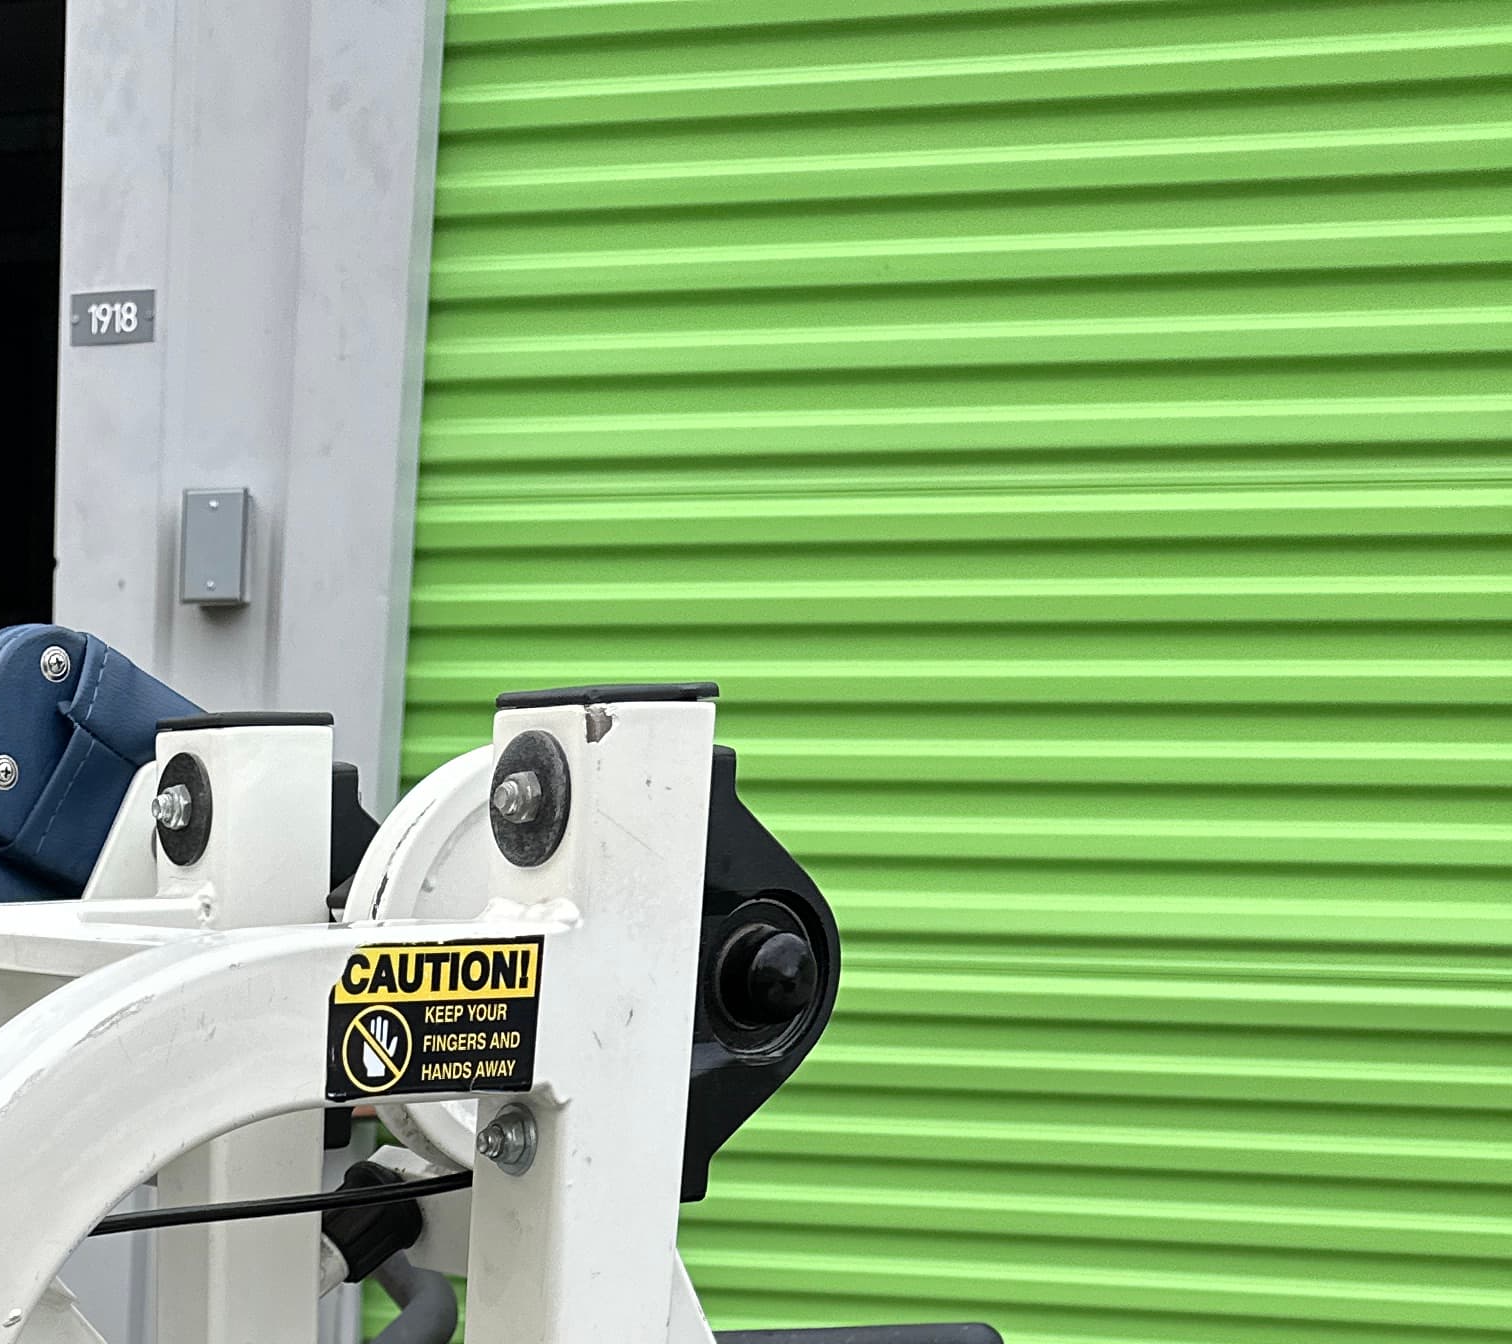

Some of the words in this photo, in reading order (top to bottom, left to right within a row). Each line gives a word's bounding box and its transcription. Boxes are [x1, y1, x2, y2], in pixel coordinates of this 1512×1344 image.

[87, 301, 139, 335] 1918
[341, 950, 531, 995] CAUTION!
[424, 1004, 464, 1024] KEEP
[468, 1003, 508, 1023] YOUR
[422, 1033, 489, 1053] FINGERS
[489, 1031, 521, 1050] AND
[420, 1061, 472, 1081] HANDS
[471, 1059, 516, 1080] AWAY
